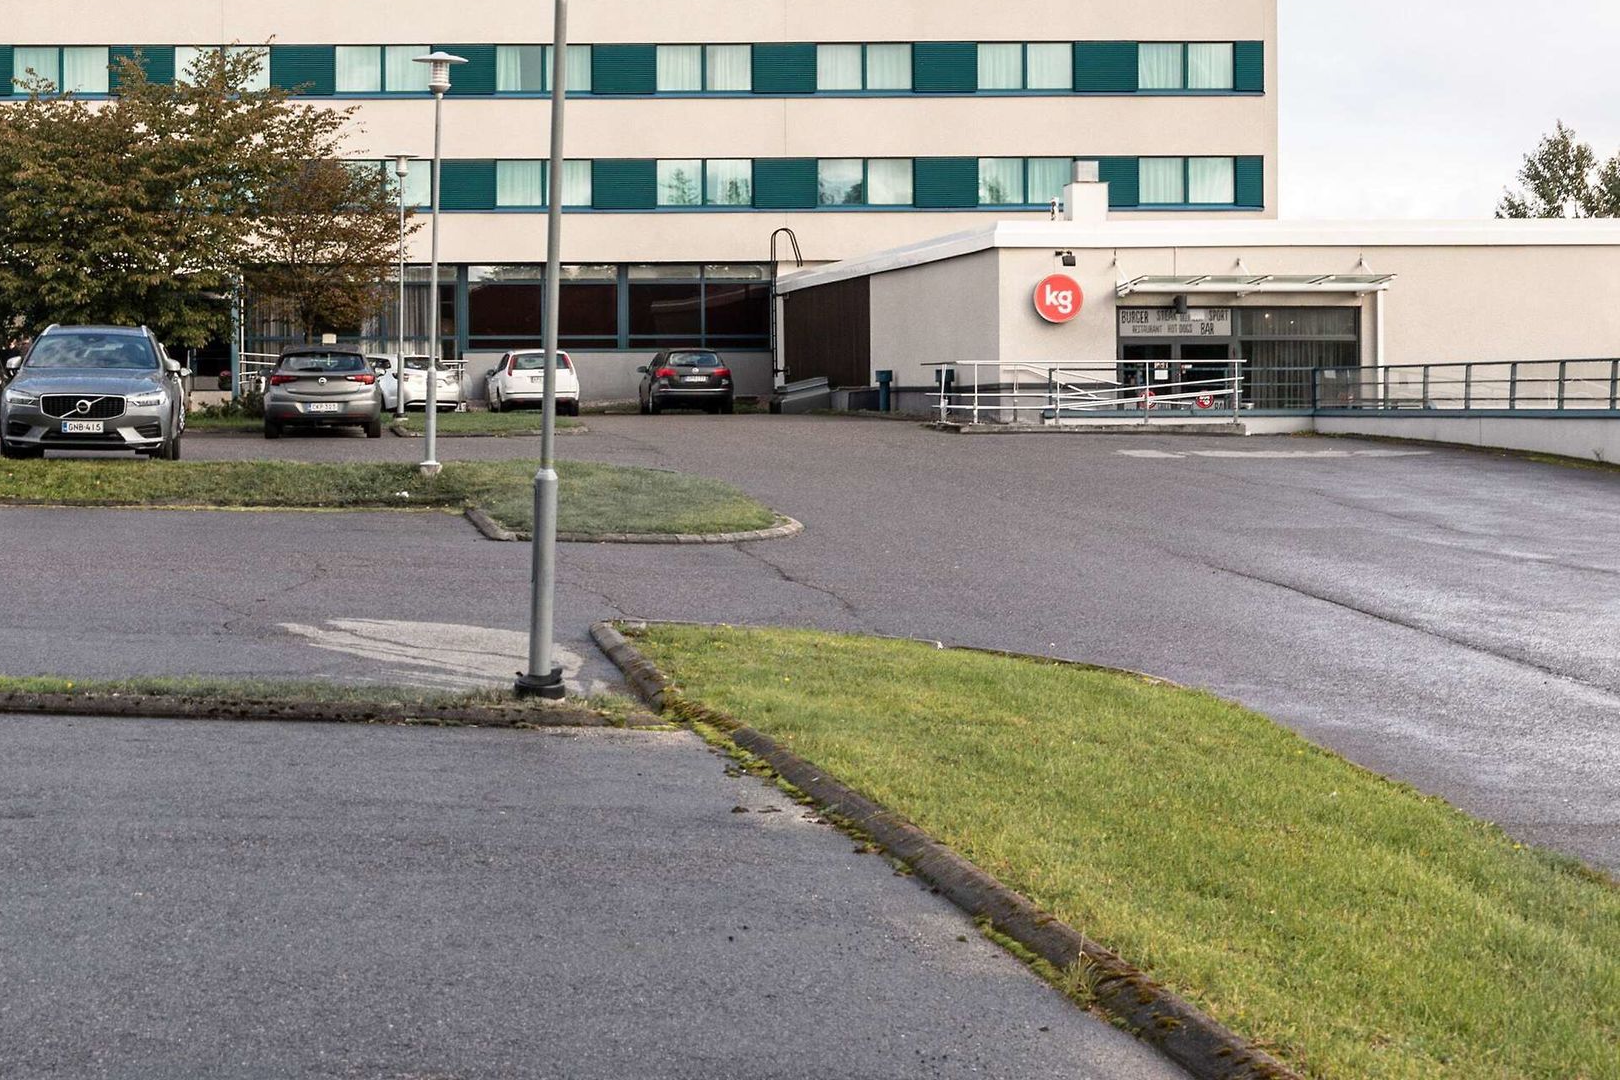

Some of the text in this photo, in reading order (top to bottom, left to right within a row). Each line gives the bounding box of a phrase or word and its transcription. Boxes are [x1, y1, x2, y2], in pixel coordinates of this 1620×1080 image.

[1045, 284, 1073, 314] kg
[1121, 310, 1149, 323] BURGER
[1156, 309, 1177, 321] STEAK
[1208, 309, 1229, 321] SPORT
[1132, 324, 1162, 333] RESTAURANT
[1200, 322, 1215, 335] BAR
[68, 423, 101, 431] GNB-415
